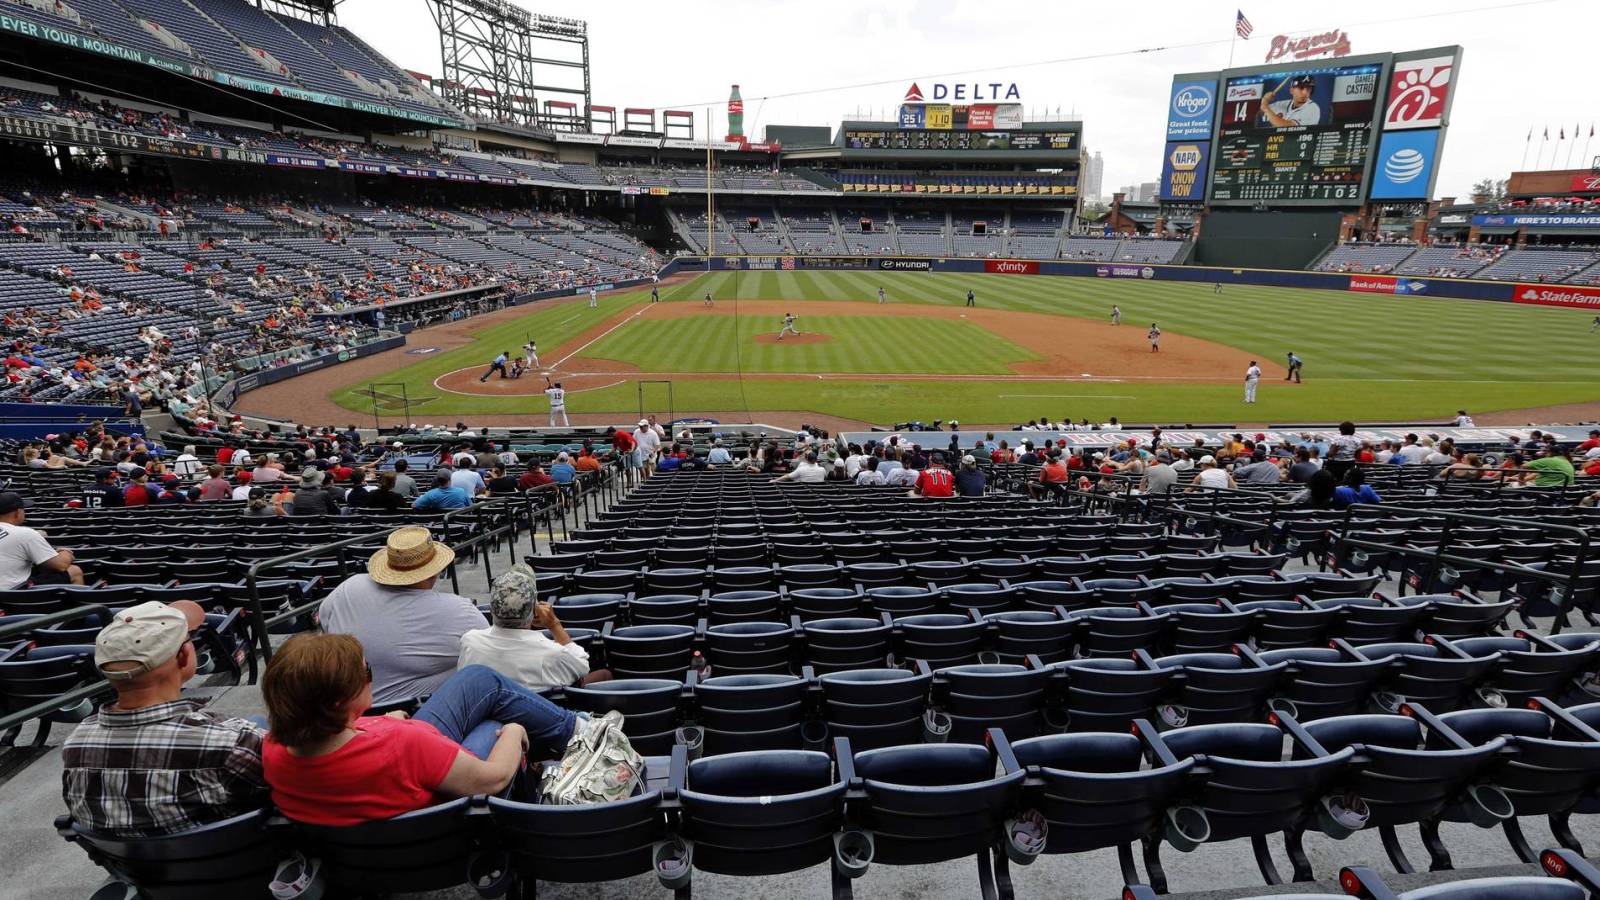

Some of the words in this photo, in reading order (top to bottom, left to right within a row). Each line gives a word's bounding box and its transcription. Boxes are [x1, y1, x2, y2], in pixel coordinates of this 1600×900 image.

[40, 26, 78, 47] YOUR
[82, 38, 142, 61] MOUNTAIN
[156, 60, 174, 70] CLIMB
[1355, 73, 1375, 84] DANIEL
[249, 83, 270, 94] LIGHT
[933, 83, 1021, 100] DELTA
[1346, 84, 1373, 95] CASTRO
[282, 89, 302, 100] CLIMB
[304, 94, 314, 102] ON
[1178, 92, 1208, 113] Kroger
[352, 101, 389, 115] WHATEVER
[390, 107, 408, 119] YOUR
[409, 112, 439, 125] MOUNTAIN
[1234, 101, 1247, 122] 14
[111, 134, 118, 145] 1
[121, 135, 128, 146] 0
[130, 137, 139, 148] 2
[1176, 152, 1197, 164] NAPA
[1171, 172, 1196, 184] KNOW
[1171, 184, 1191, 197] HOW
[1324, 189, 1329, 198] 1
[1335, 188, 1344, 198] 0
[1349, 188, 1357, 198] 2
[895, 261, 929, 269] HYUNDAI
[996, 260, 1028, 273] xfinity
[1350, 280, 1368, 288] Bank
[931, 471, 948, 486] 11
[86, 496, 102, 509] 12
[1547, 857, 1562, 873] 106
